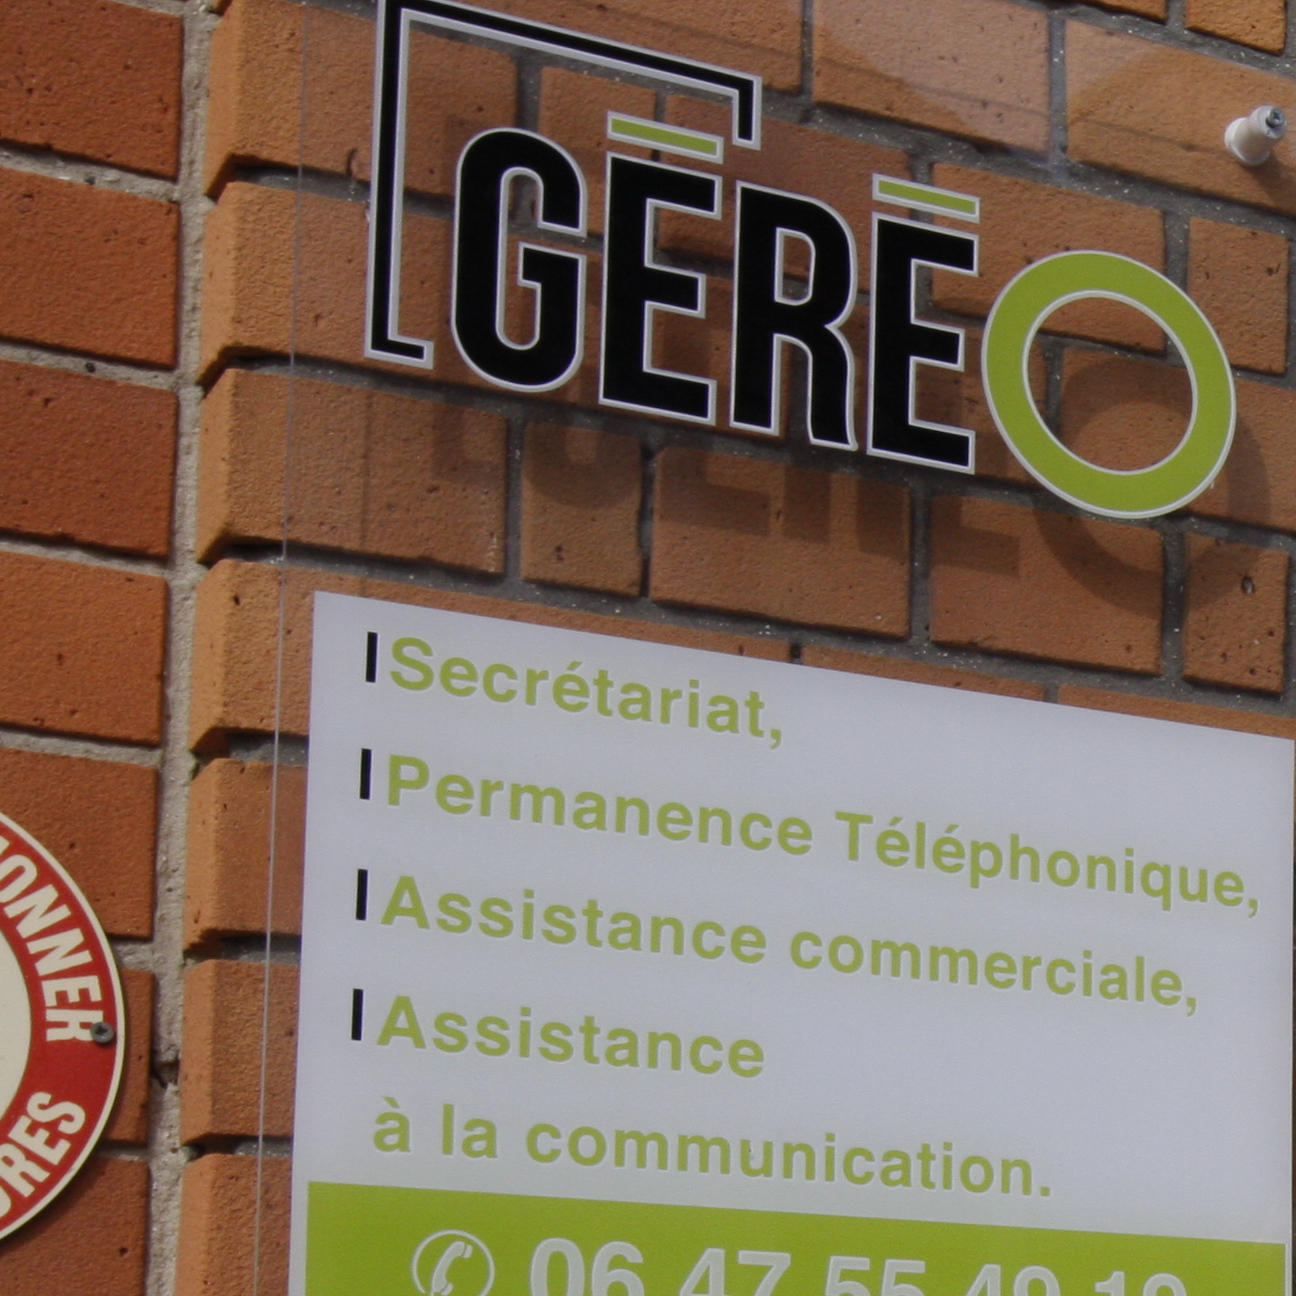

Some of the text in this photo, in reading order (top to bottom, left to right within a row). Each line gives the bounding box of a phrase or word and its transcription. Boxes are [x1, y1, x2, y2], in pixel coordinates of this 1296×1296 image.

[390, 636, 783, 748] Secrétariat,
[387, 754, 1259, 917] Permanence Téléphonique,
[0, 836, 104, 1042] ONNER
[380, 875, 1198, 1015] Assistance commerciale,
[376, 995, 764, 1078] Assistance
[373, 1097, 1053, 1197] à la communication.
